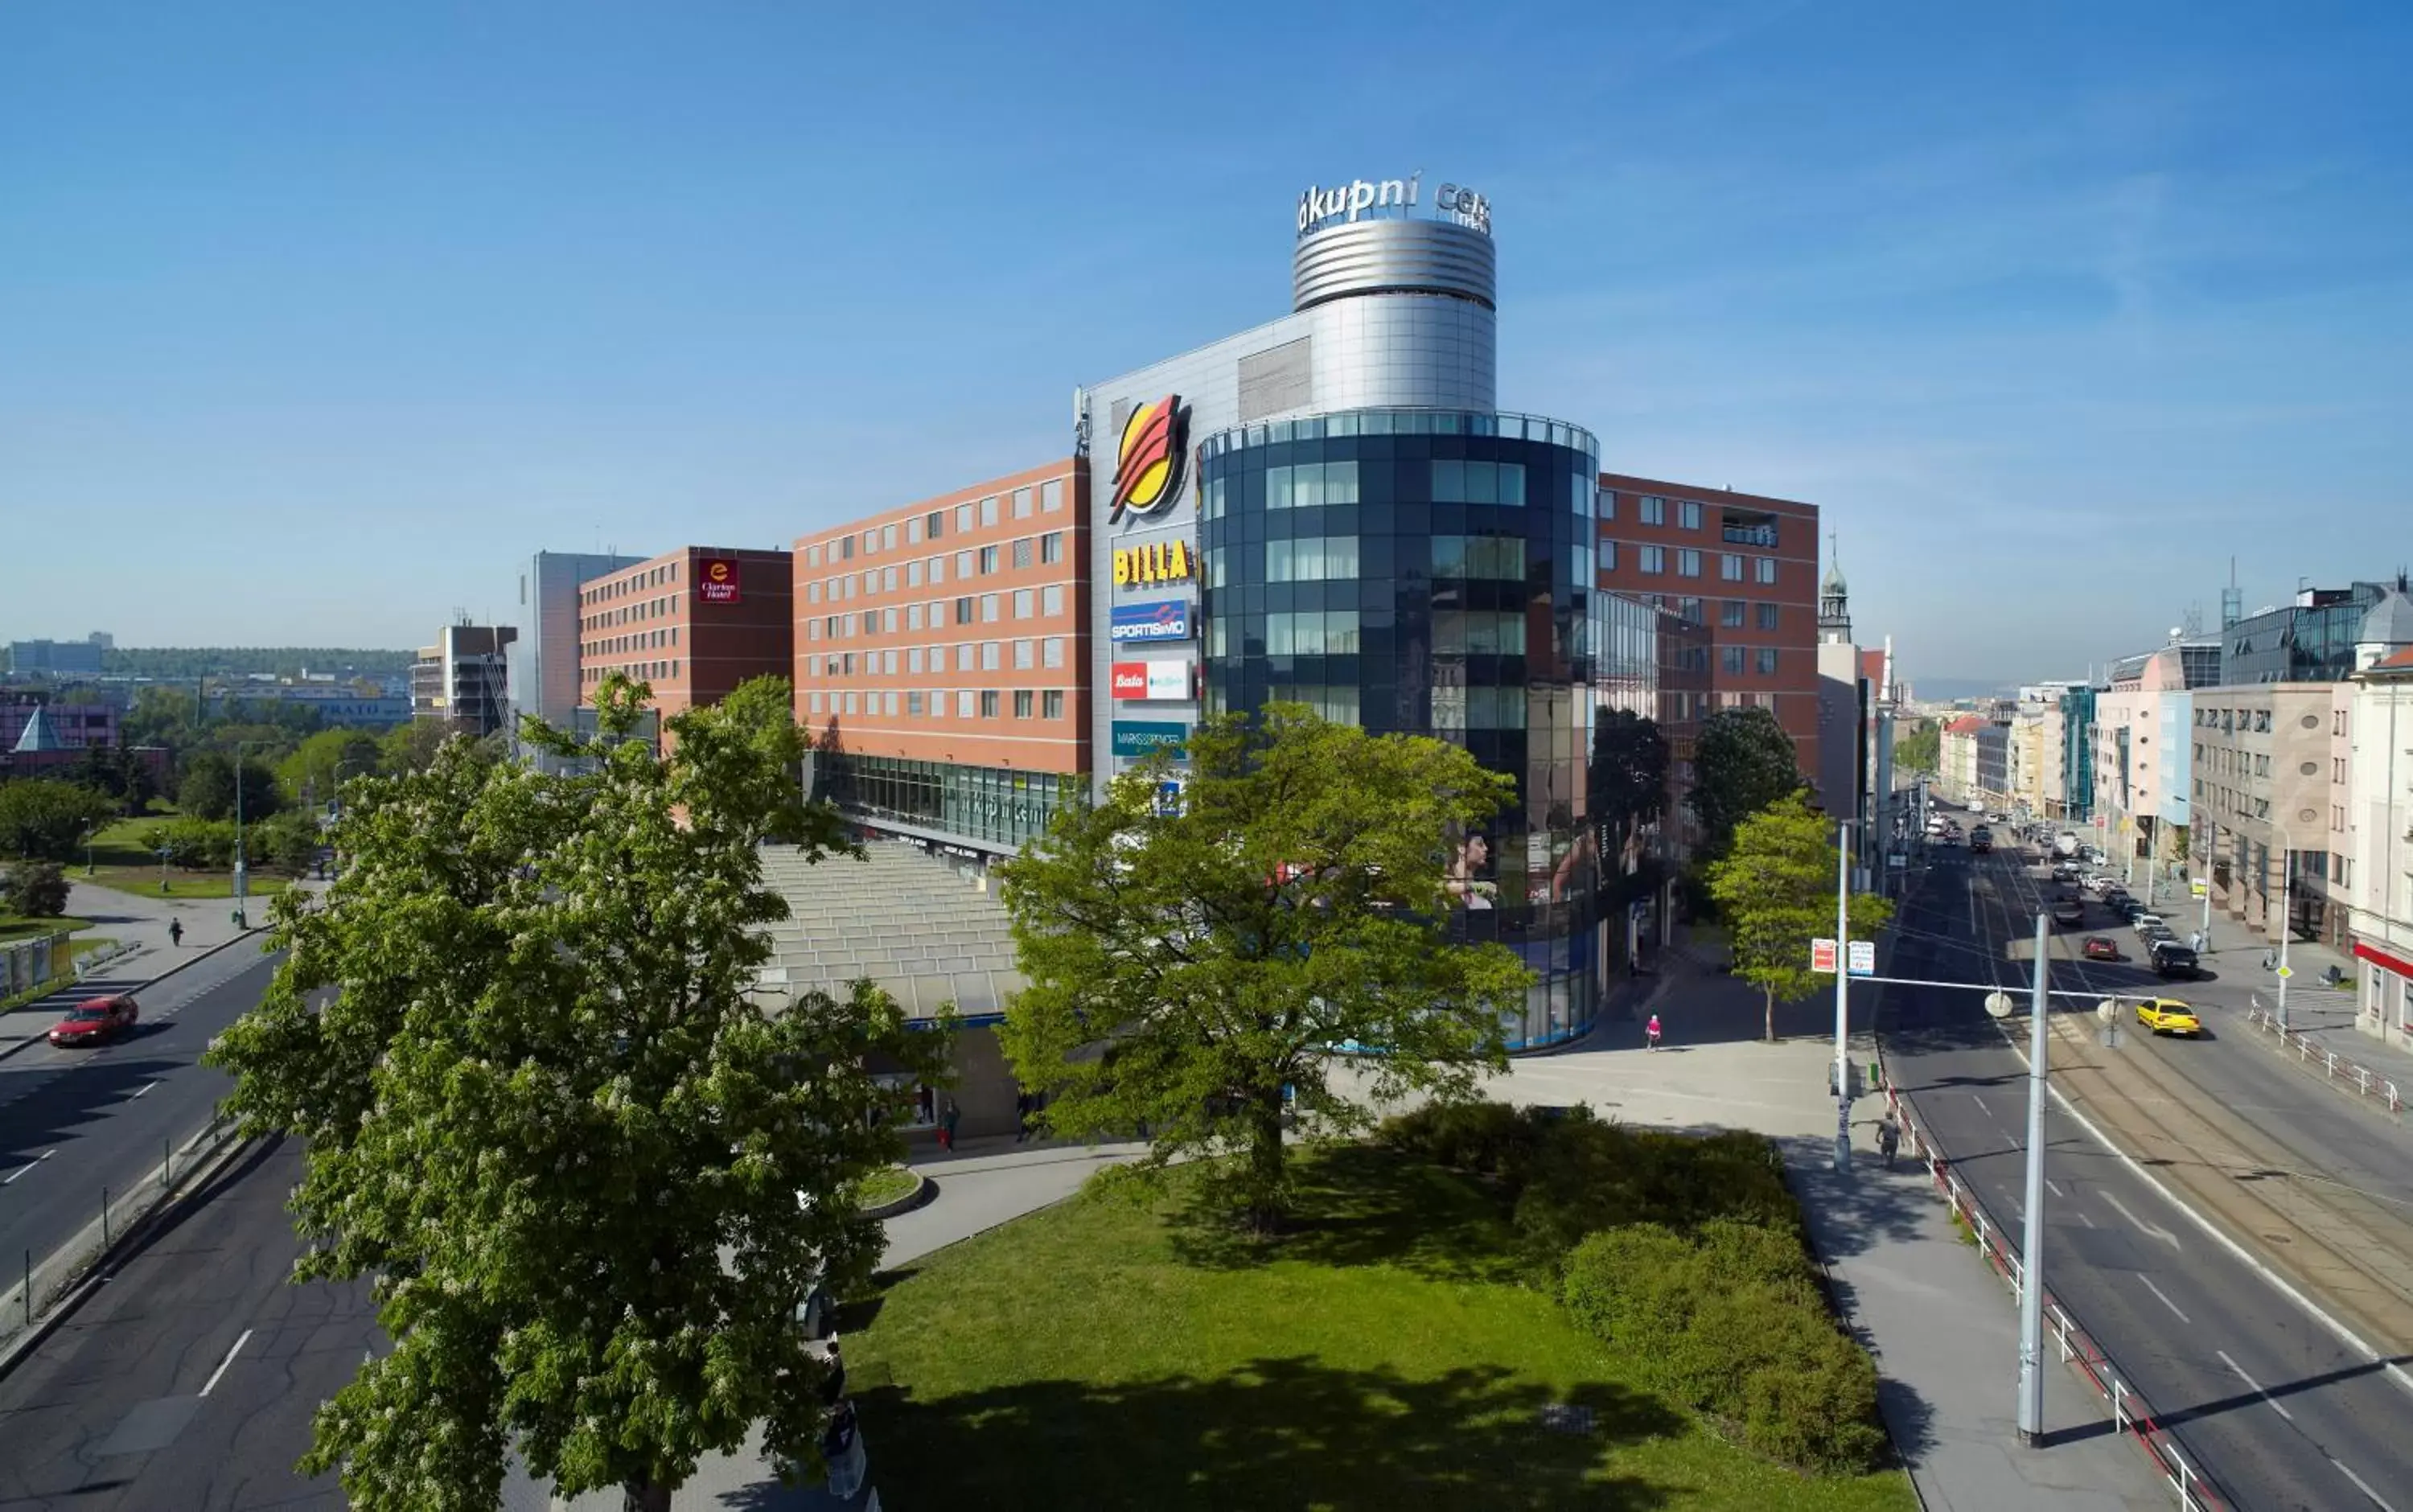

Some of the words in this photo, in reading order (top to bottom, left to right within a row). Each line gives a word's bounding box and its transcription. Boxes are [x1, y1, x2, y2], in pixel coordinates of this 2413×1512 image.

[1113, 540, 1188, 585] BILLA
[701, 582, 736, 591] Clarion
[706, 590, 731, 599] Hotel
[1112, 620, 1185, 638] SPORTISIMO
